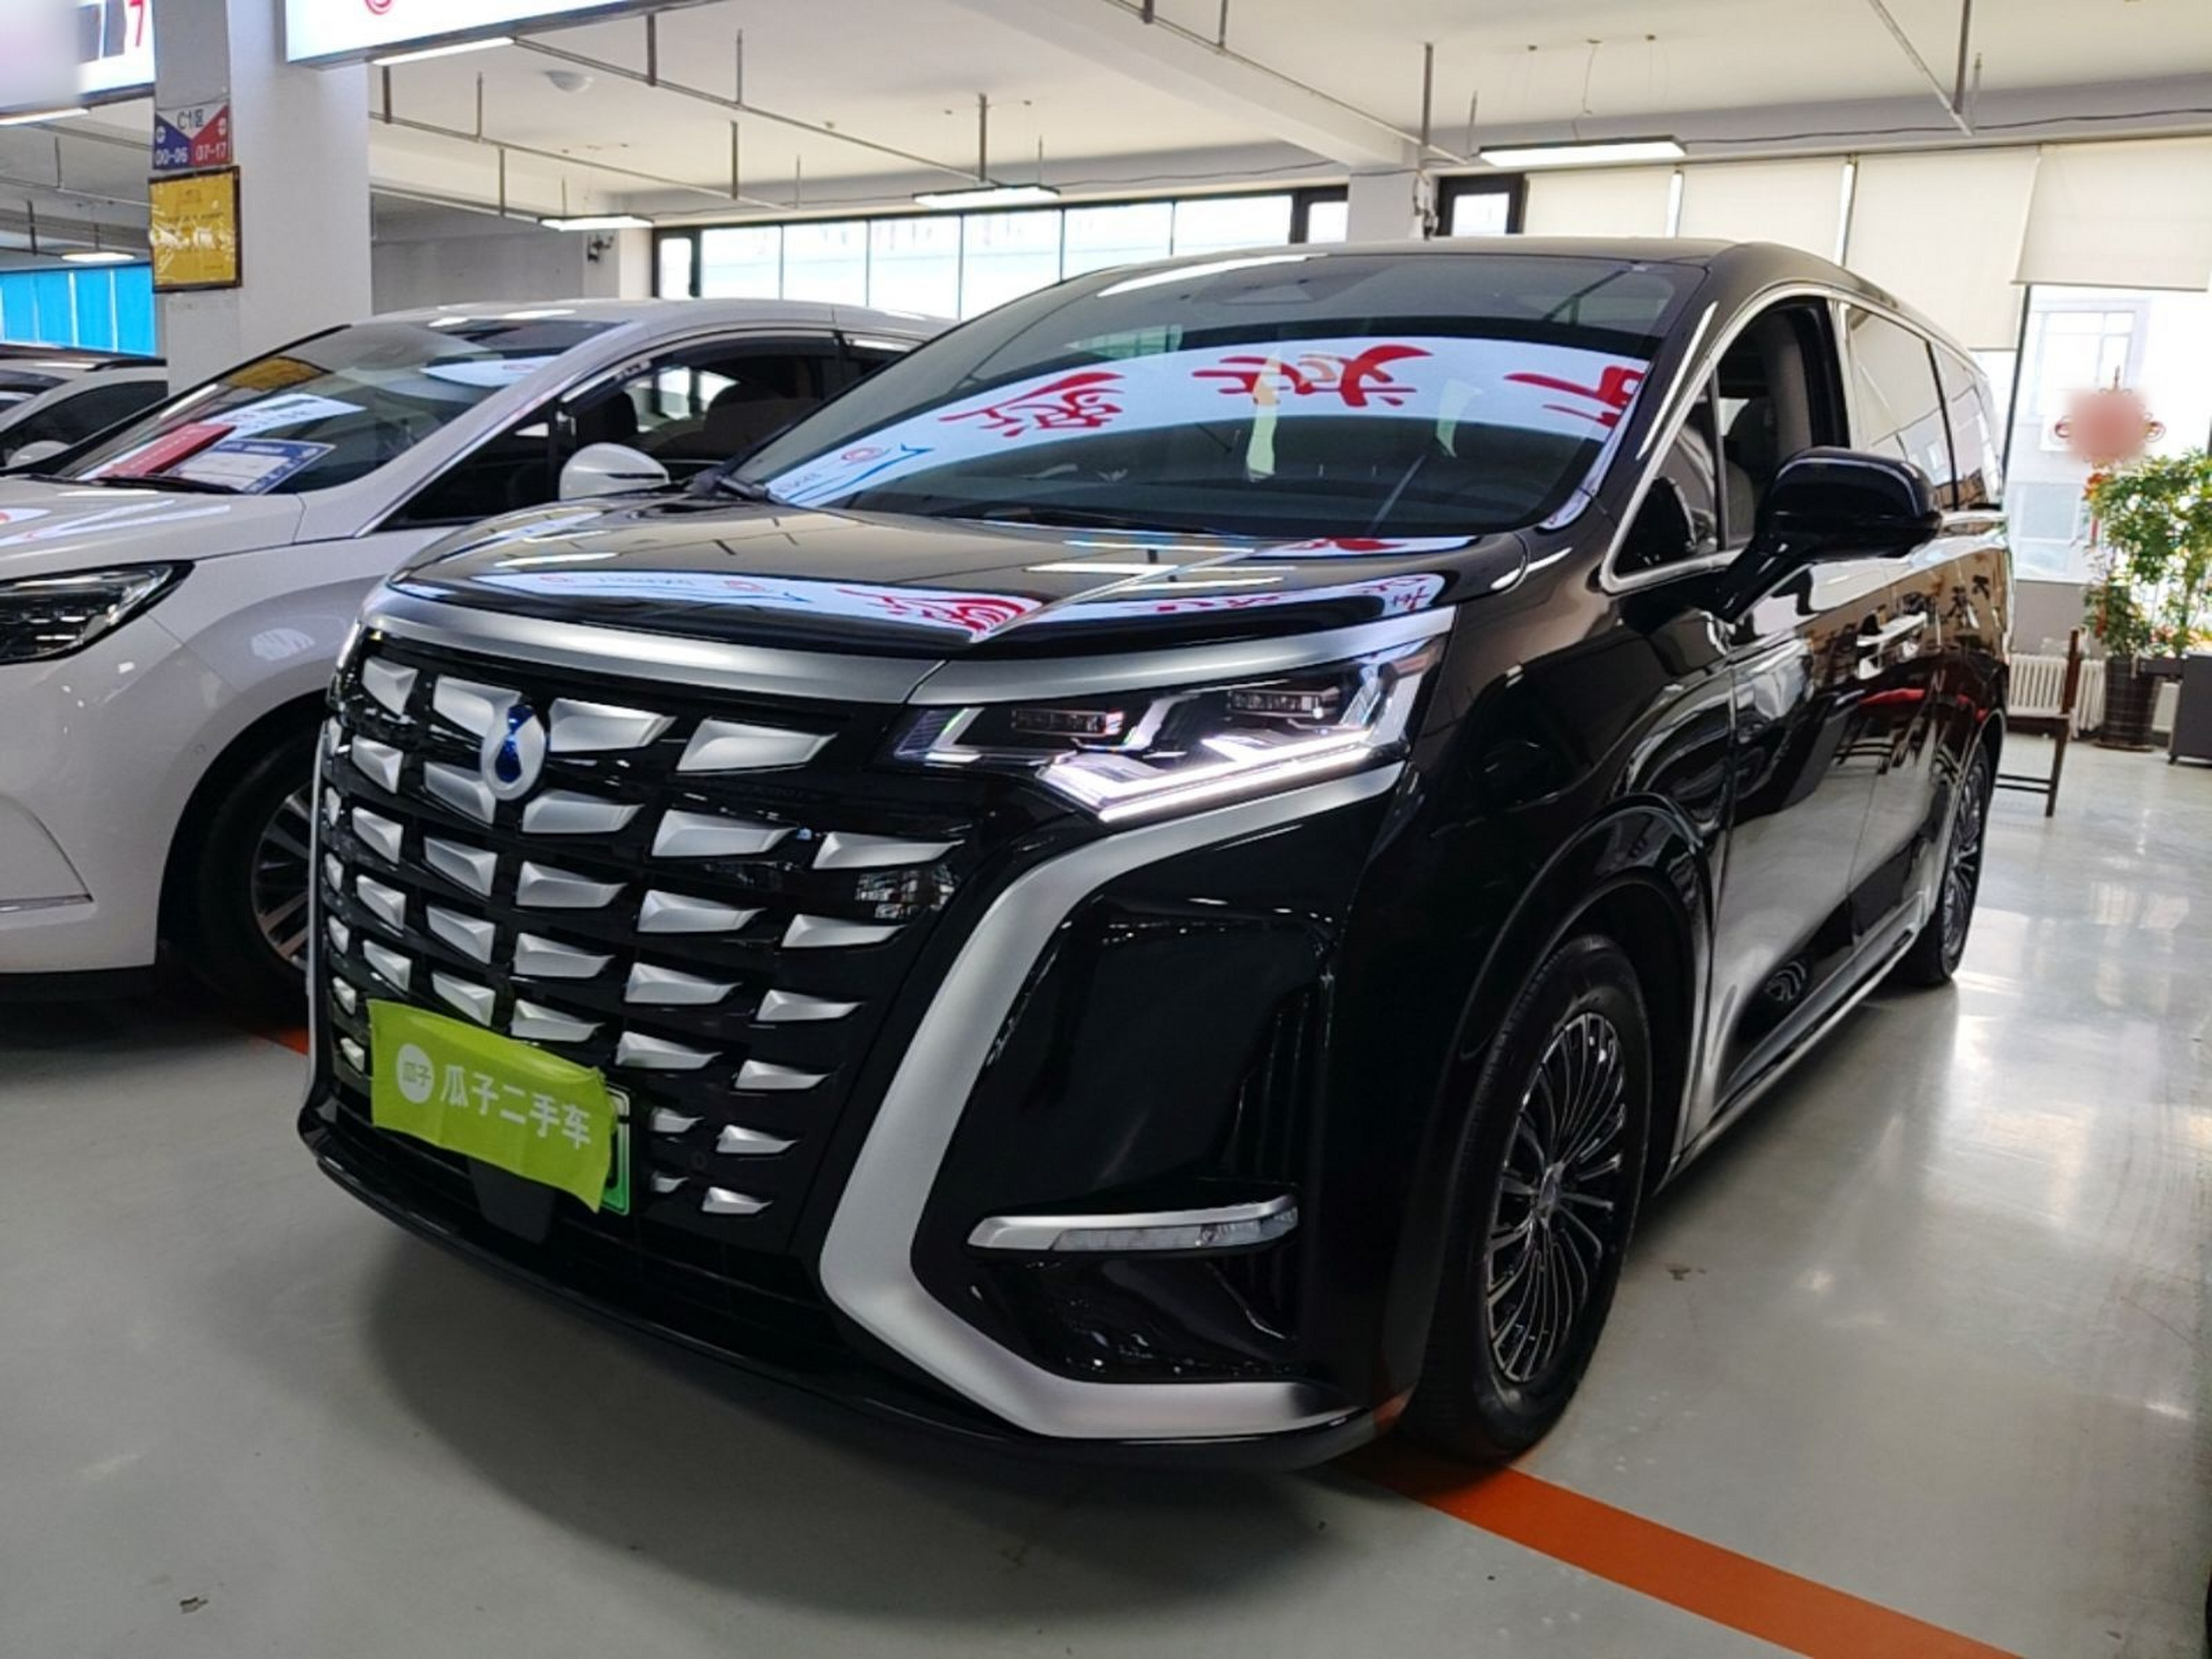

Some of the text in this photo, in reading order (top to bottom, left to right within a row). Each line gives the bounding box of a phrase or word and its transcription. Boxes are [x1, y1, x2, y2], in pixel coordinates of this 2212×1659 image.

[440, 1064, 591, 1150] 瓜子二手车
